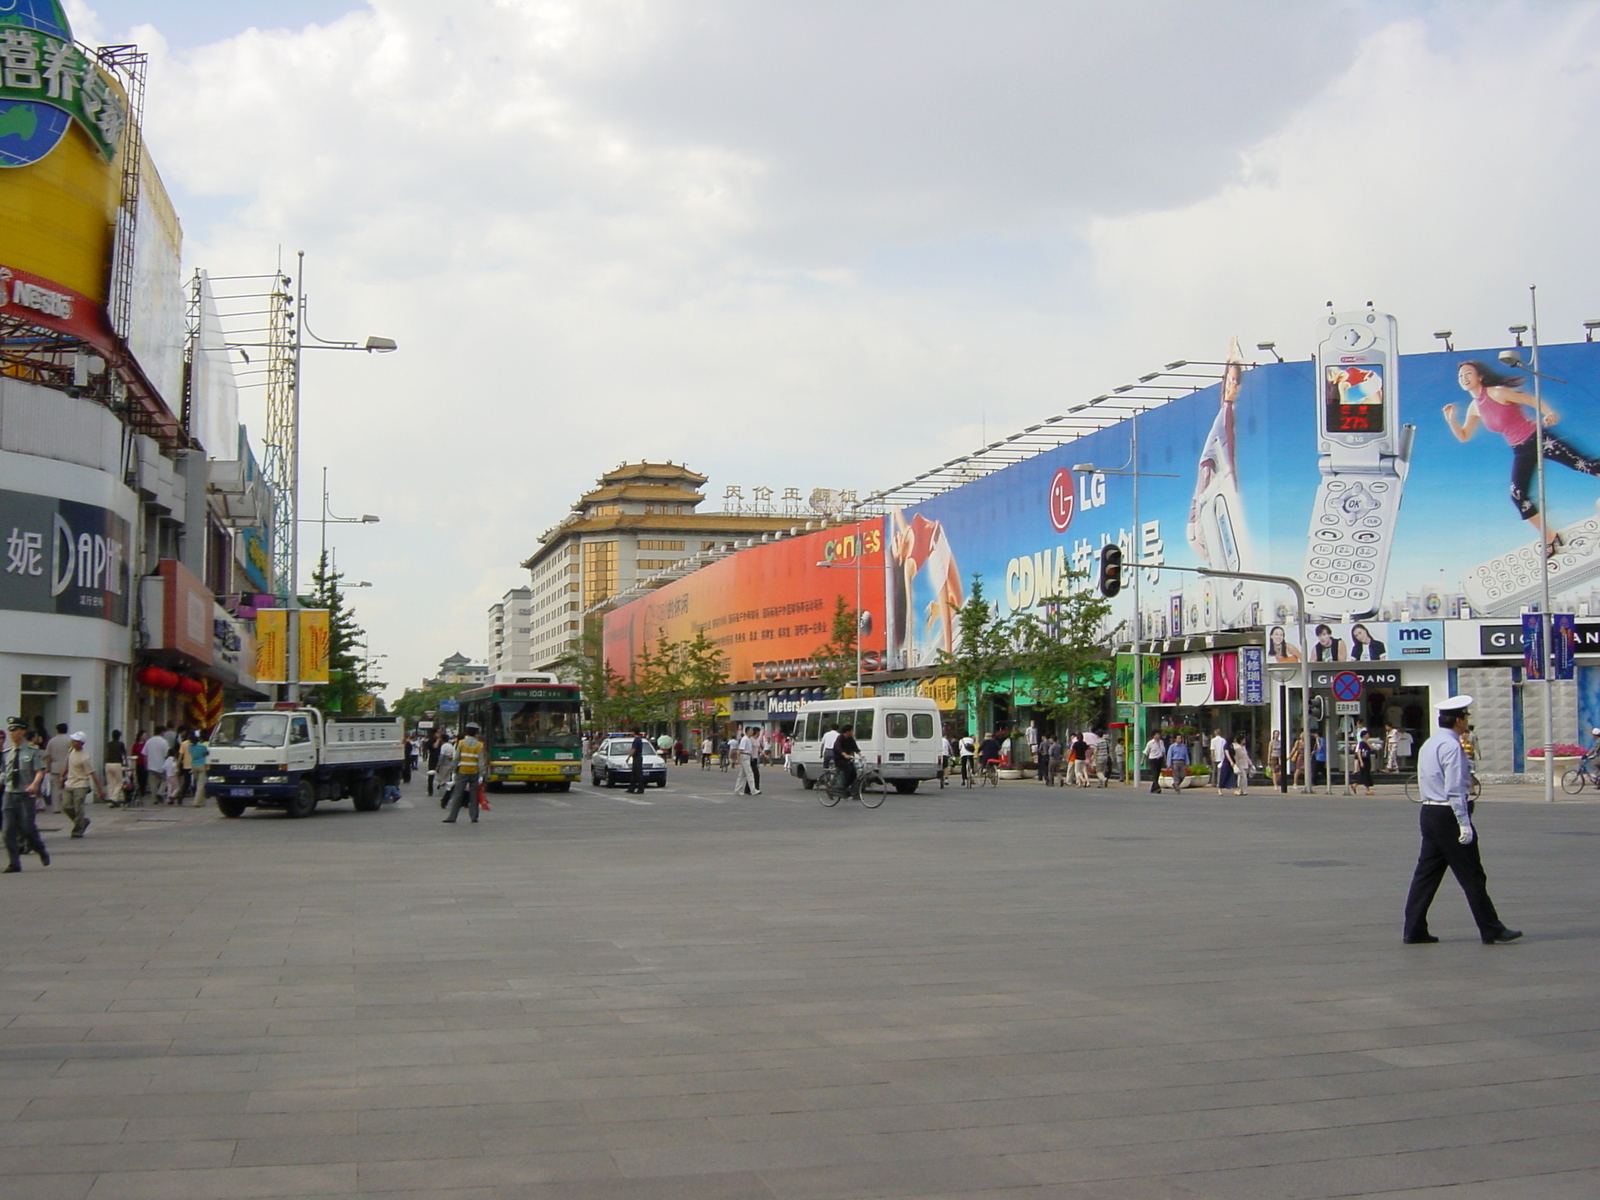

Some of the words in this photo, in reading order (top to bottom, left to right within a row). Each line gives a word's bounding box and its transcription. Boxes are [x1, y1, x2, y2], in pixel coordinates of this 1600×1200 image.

[1078, 469, 1106, 512] LG
[1348, 500, 1362, 508] OK
[6, 527, 43, 576] 妮
[1006, 546, 1070, 611] CDMA
[1399, 628, 1433, 641] me
[1317, 674, 1396, 684] GIDANO
